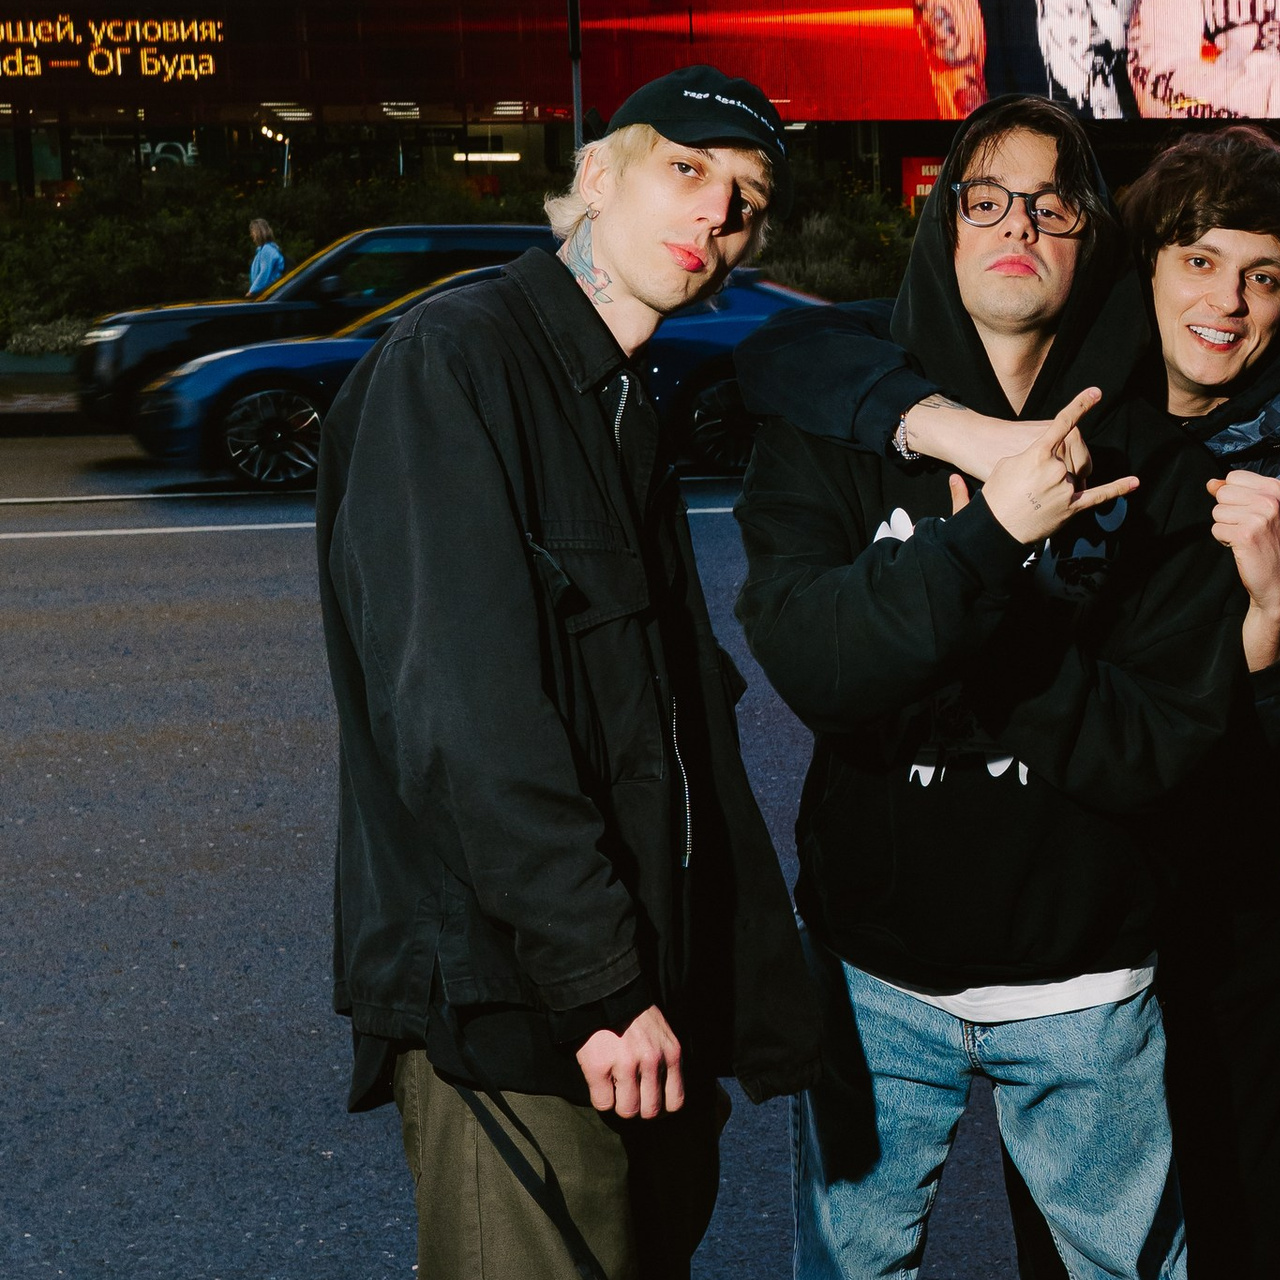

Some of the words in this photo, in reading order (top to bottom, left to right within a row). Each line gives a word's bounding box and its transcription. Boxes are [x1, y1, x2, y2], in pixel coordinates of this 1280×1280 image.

[0, 14, 82, 48] щей,
[88, 19, 224, 47] условия:
[0, 47, 42, 76] da
[88, 47, 131, 76] ОГ
[140, 47, 216, 83] Буда
[683, 90, 710, 100] rage
